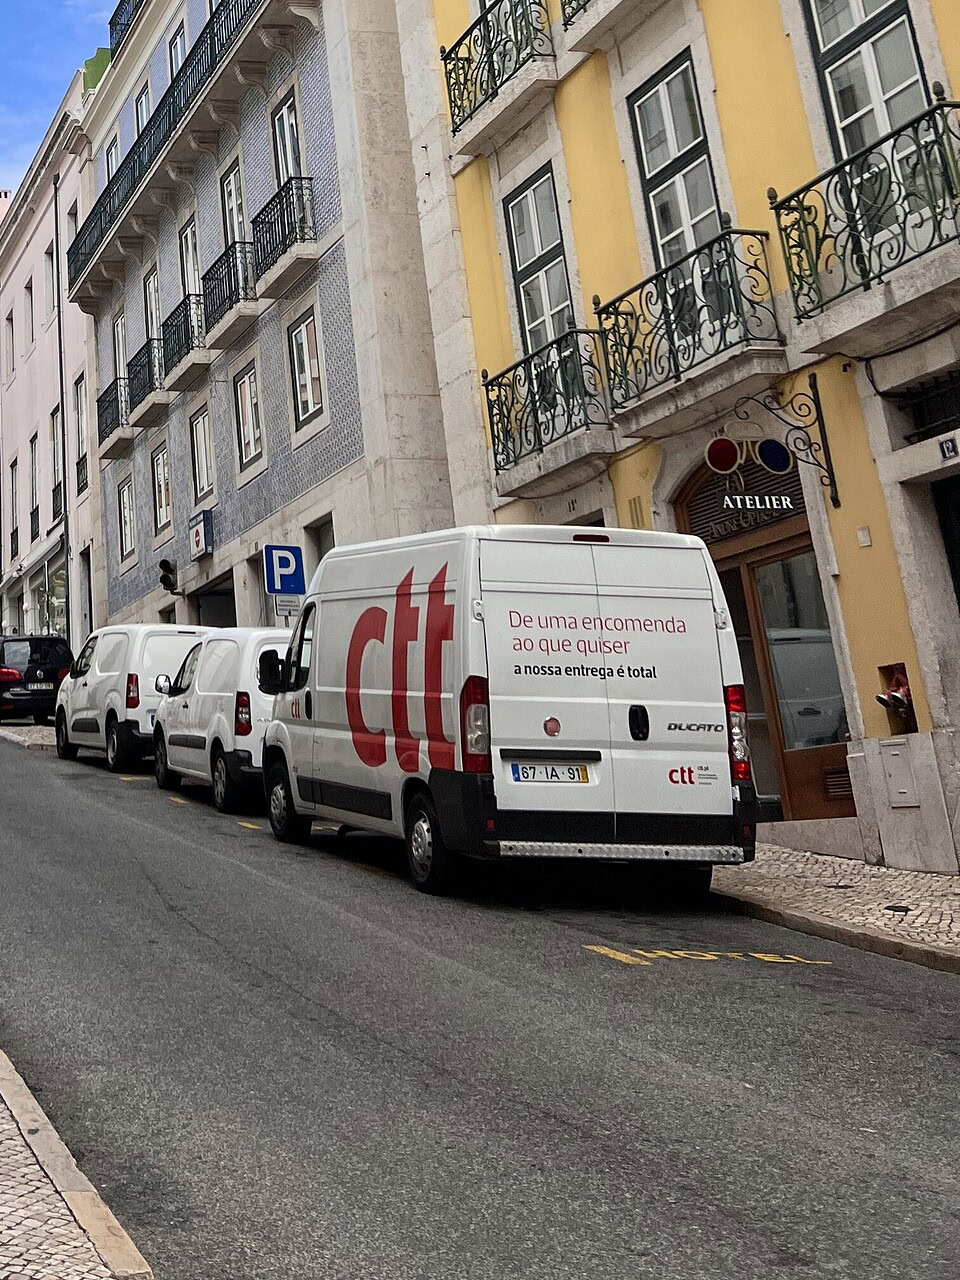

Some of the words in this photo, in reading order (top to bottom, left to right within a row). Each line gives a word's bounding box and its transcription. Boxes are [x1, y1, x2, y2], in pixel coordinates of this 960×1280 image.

[722, 495, 794, 509] ATELIER
[272, 549, 297, 590] P
[509, 610, 533, 628] De
[537, 615, 578, 630] uma
[582, 616, 687, 634] encomenda
[512, 637, 534, 652] ao
[538, 638, 572, 656] que
[576, 637, 630, 657] quiser
[345, 561, 455, 773] ctt
[514, 664, 522, 675] a
[524, 664, 562, 676] nossa
[565, 664, 614, 680] entrega
[617, 664, 625, 678] é
[627, 665, 657, 679] total
[667, 723, 724, 732] DUCATO
[668, 766, 695, 785] ctt
